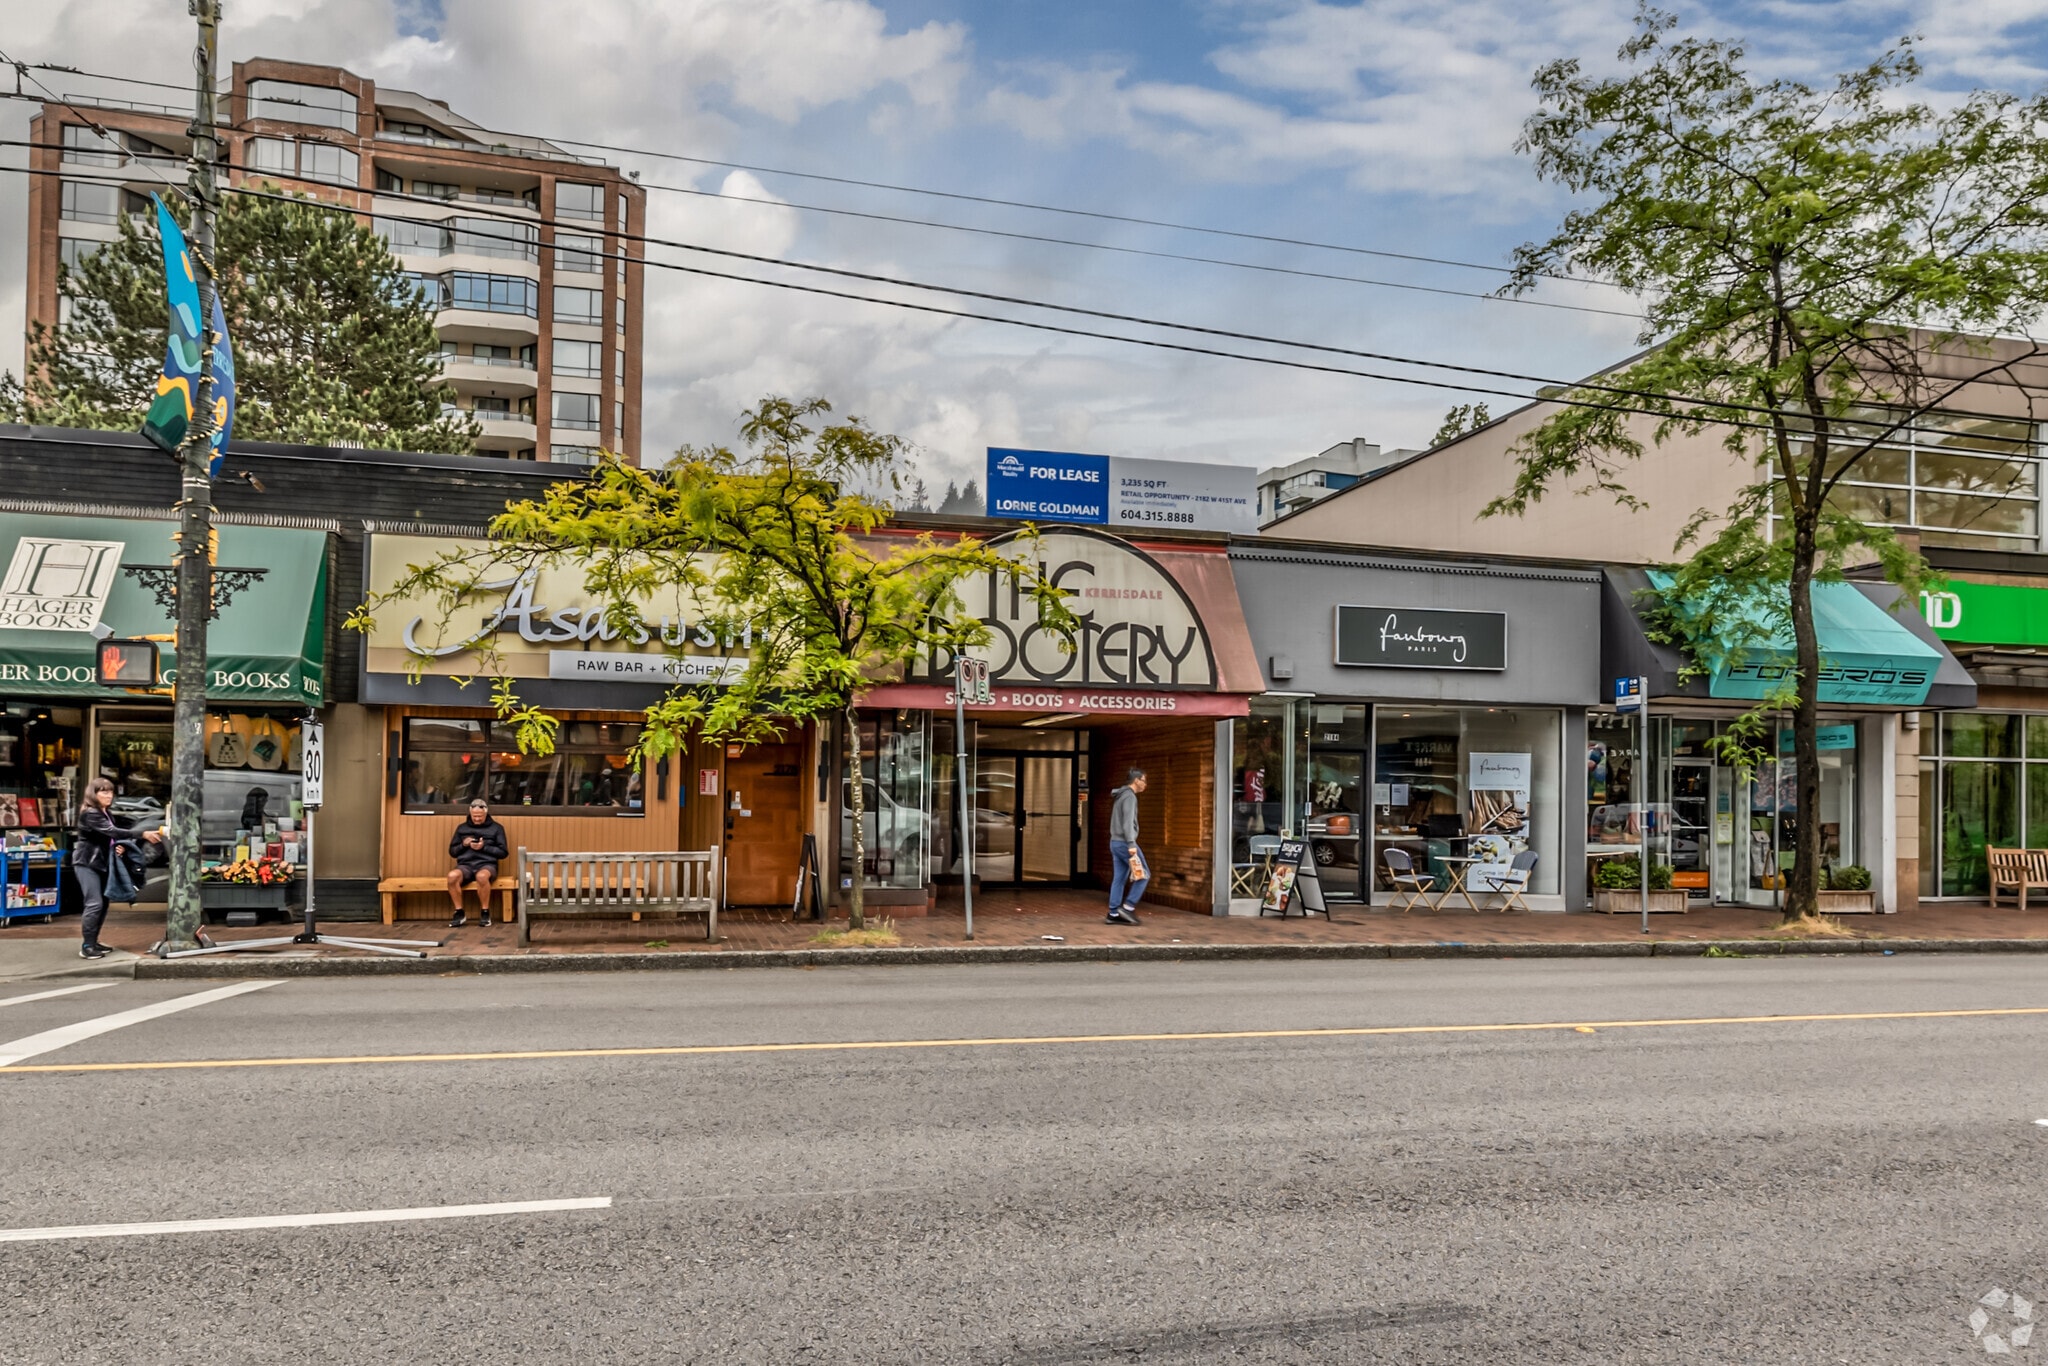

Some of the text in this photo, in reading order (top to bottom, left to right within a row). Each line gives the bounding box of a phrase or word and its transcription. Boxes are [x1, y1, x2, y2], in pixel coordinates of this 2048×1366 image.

[1030, 467, 1100, 482] FOR LEASE
[1121, 479, 1142, 487] 3,235
[1144, 480, 1155, 488] SQ
[1144, 492, 1190, 500] OPPORTUNITY
[996, 500, 1099, 515] LORNE GOLDMAN
[1121, 510, 1194, 523] 604.315.8888
[1085, 587, 1162, 600] KERRISDALE
[1, 599, 93, 615] HAGER
[1920, 591, 1962, 629] TD
[0, 612, 91, 629] BOOKS
[929, 616, 1196, 684] BOOTERY
[577, 660, 609, 671] RAW
[615, 662, 643, 673] BAR
[663, 663, 724, 677] KITCHEN
[213, 671, 290, 688] BOOKS
[1012, 694, 1063, 707] BOOTS
[1079, 696, 1176, 710] ACCESSORIES
[127, 741, 155, 751] 2176
[306, 750, 320, 783] 30
